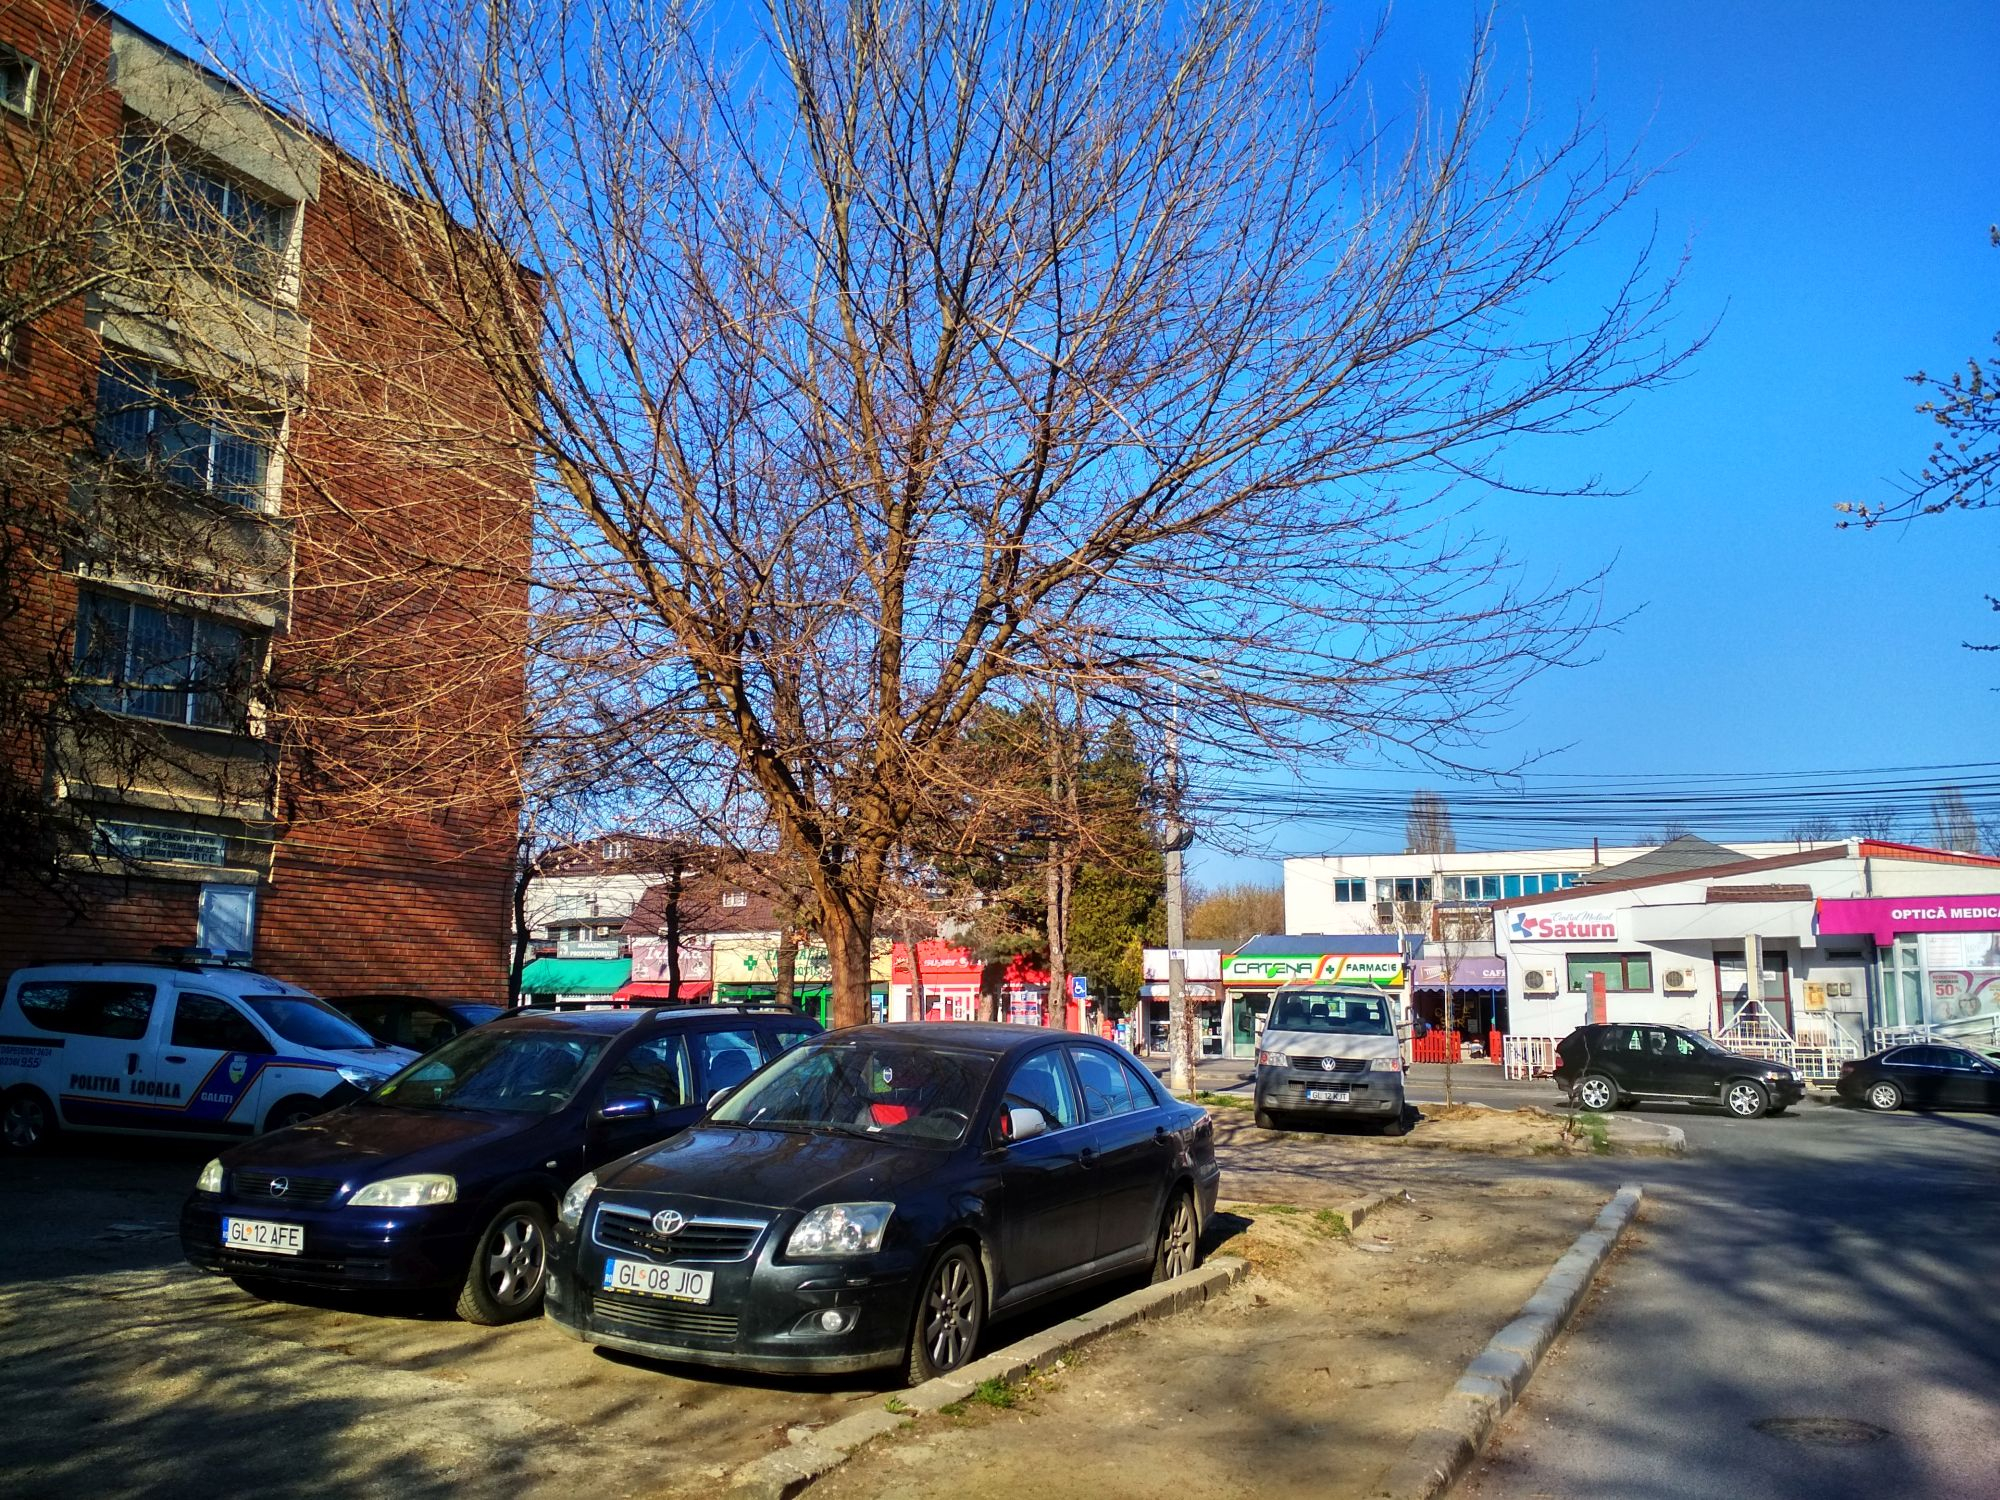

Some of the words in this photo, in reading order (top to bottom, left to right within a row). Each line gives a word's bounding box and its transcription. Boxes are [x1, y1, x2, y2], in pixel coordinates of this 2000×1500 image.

[1891, 906, 1947, 920] OPTICĂ
[1950, 907, 2000, 919] MEDIC
[1538, 918, 1615, 938] Saturn
[1233, 962, 1312, 974] CATENA
[1346, 963, 1397, 972] FARMACIE
[70, 1073, 120, 1094] POLITIA
[130, 1079, 181, 1099] LOCALA
[201, 1092, 233, 1104] GALATI
[232, 1222, 249, 1242] GL
[254, 1224, 267, 1244] 12
[270, 1226, 300, 1247] AFE
[620, 1264, 640, 1287] GL
[647, 1268, 670, 1290] 08
[675, 1271, 704, 1294] JIO
